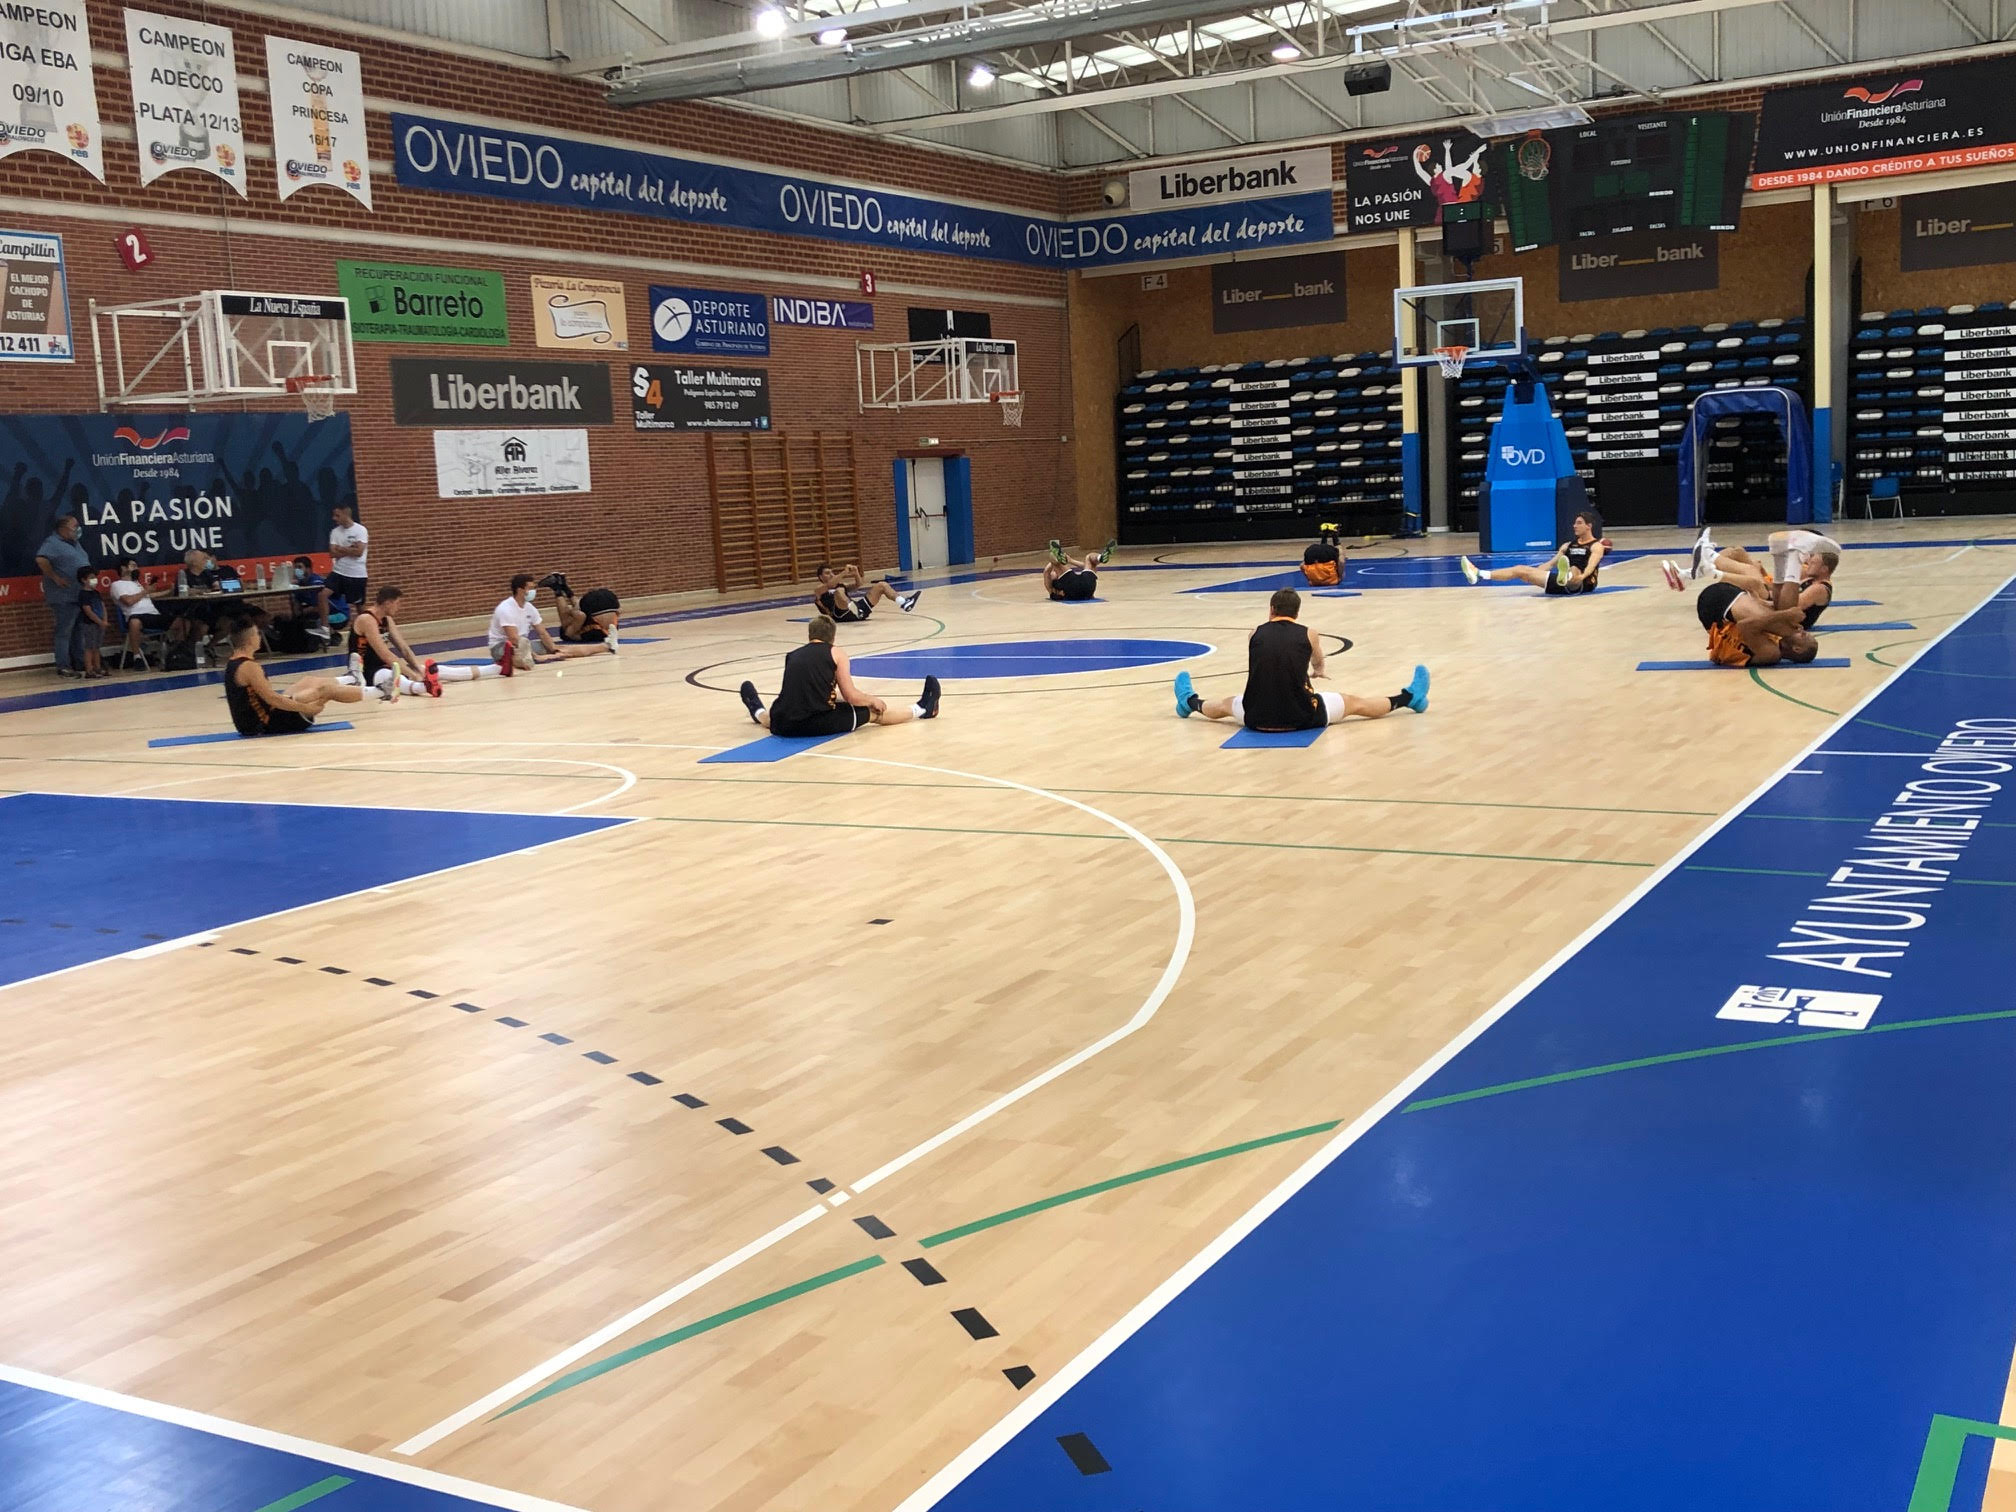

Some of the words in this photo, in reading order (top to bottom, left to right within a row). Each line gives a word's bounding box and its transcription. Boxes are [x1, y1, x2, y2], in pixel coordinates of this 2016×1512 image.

[139, 28, 225, 58] CAMPEON
[41, 48, 78, 71] EBA
[287, 53, 343, 74] CAMPEON
[150, 67, 223, 93] ADECCO
[13, 83, 64, 107] 09/10
[302, 81, 334, 97] COPA
[139, 102, 195, 126] PLATA
[199, 112, 240, 133] 12/13
[292, 105, 349, 125] PRINCESA
[1820, 98, 1947, 124] UniónFinancieraAsturiana
[1638, 121, 1668, 130] VISITANTE
[1858, 117, 1884, 129] Desde
[1885, 115, 1907, 126] 1984
[308, 134, 337, 148] 16/17
[1579, 130, 1598, 138] LOCAL
[154, 142, 199, 157] OVIEDO
[1784, 126, 1985, 160] WWW.UNIONFINANCIERA.ES
[289, 160, 328, 174] OVIEDO
[404, 125, 563, 189] OVIEDO
[570, 172, 634, 201] capital
[638, 175, 665, 206] del
[669, 179, 728, 214] deporte
[1758, 174, 1795, 188] DESDE
[1797, 171, 1823, 184] 1984
[1826, 165, 1869, 180] DANDO
[1872, 157, 1923, 174] CRÉDITO
[1926, 157, 1937, 168] A
[1939, 153, 1962, 166] TUS
[1965, 145, 2015, 163] SUEÑOS
[1160, 160, 1297, 200] Liberbank
[1354, 196, 1371, 208] LA
[1374, 188, 1422, 206] PASIÓN
[780, 184, 883, 233] OVIEDO
[886, 217, 928, 242] capital
[930, 219, 950, 244] del
[951, 222, 991, 251] deporte
[1355, 213, 1381, 225] NOS
[1385, 210, 1410, 222] UNE
[1916, 219, 1971, 237] Liber
[1026, 223, 1128, 259] OVIEDO
[1133, 226, 1196, 254] capital
[1201, 222, 1230, 244] del
[1236, 213, 1306, 242] deporte
[0, 240, 56, 260] ampillin
[125, 234, 147, 264] 2
[1572, 252, 1619, 271] Liber
[1657, 243, 1704, 262] bank
[10, 273, 20, 283] EL
[21, 274, 49, 285] MEJOR
[436, 273, 488, 287] FUNCIONAL
[864, 273, 873, 294] 3
[1144, 276, 1152, 289] F
[1156, 275, 1165, 288] 4
[1222, 287, 1262, 305] Liber
[1294, 280, 1334, 298] bank
[22, 299, 33, 308] DE
[249, 297, 262, 313] La
[264, 298, 289, 314] Nueva
[291, 300, 321, 317] España
[393, 286, 484, 319] Barreto
[693, 300, 751, 319] DEPORTE
[6, 310, 46, 321] ASTURIAS
[695, 319, 766, 338] ASTURIANO
[1960, 326, 2012, 338] Liberbank
[18, 336, 40, 352] 411
[1601, 353, 1645, 363] Liberbank
[1960, 348, 2012, 359] Liberbank
[674, 370, 705, 385] Taller
[706, 371, 762, 387] Multimarca
[1600, 374, 1643, 384] Liberbank
[1960, 368, 2012, 379] Liberbank
[431, 374, 583, 411] Liberbank
[632, 367, 664, 409] S4
[1241, 381, 1278, 391] Liberbank
[1600, 393, 1644, 403] Liberbank
[1960, 389, 2012, 400] Liberbank
[1241, 401, 1278, 411] Liberbank
[635, 411, 655, 420] Taller
[1601, 412, 1645, 421] Liberbank
[1959, 409, 2010, 420] Liberbank
[636, 420, 675, 429] Multimarca
[1242, 418, 1279, 427] Liberbank
[1242, 436, 1280, 445] Liberbank
[1601, 431, 1645, 441] Liberbank
[1959, 430, 2010, 441] Liberbank
[92, 452, 215, 467] UniónFinancieraAsturiana
[1244, 452, 1280, 461] Liberbank
[1506, 449, 1546, 466] OVD
[1601, 450, 1645, 459] Liberbank
[133, 468, 158, 478] Desde
[159, 468, 180, 479] 1984
[1243, 470, 1280, 478] Liberbank
[81, 501, 120, 526] LA
[130, 490, 233, 523] PASIÓN
[100, 530, 160, 556] NOS
[169, 526, 224, 551] UNE
[1765, 778, 2002, 979] AYUNTAMIENTO
[1921, 718, 2016, 774] OVIEDO
